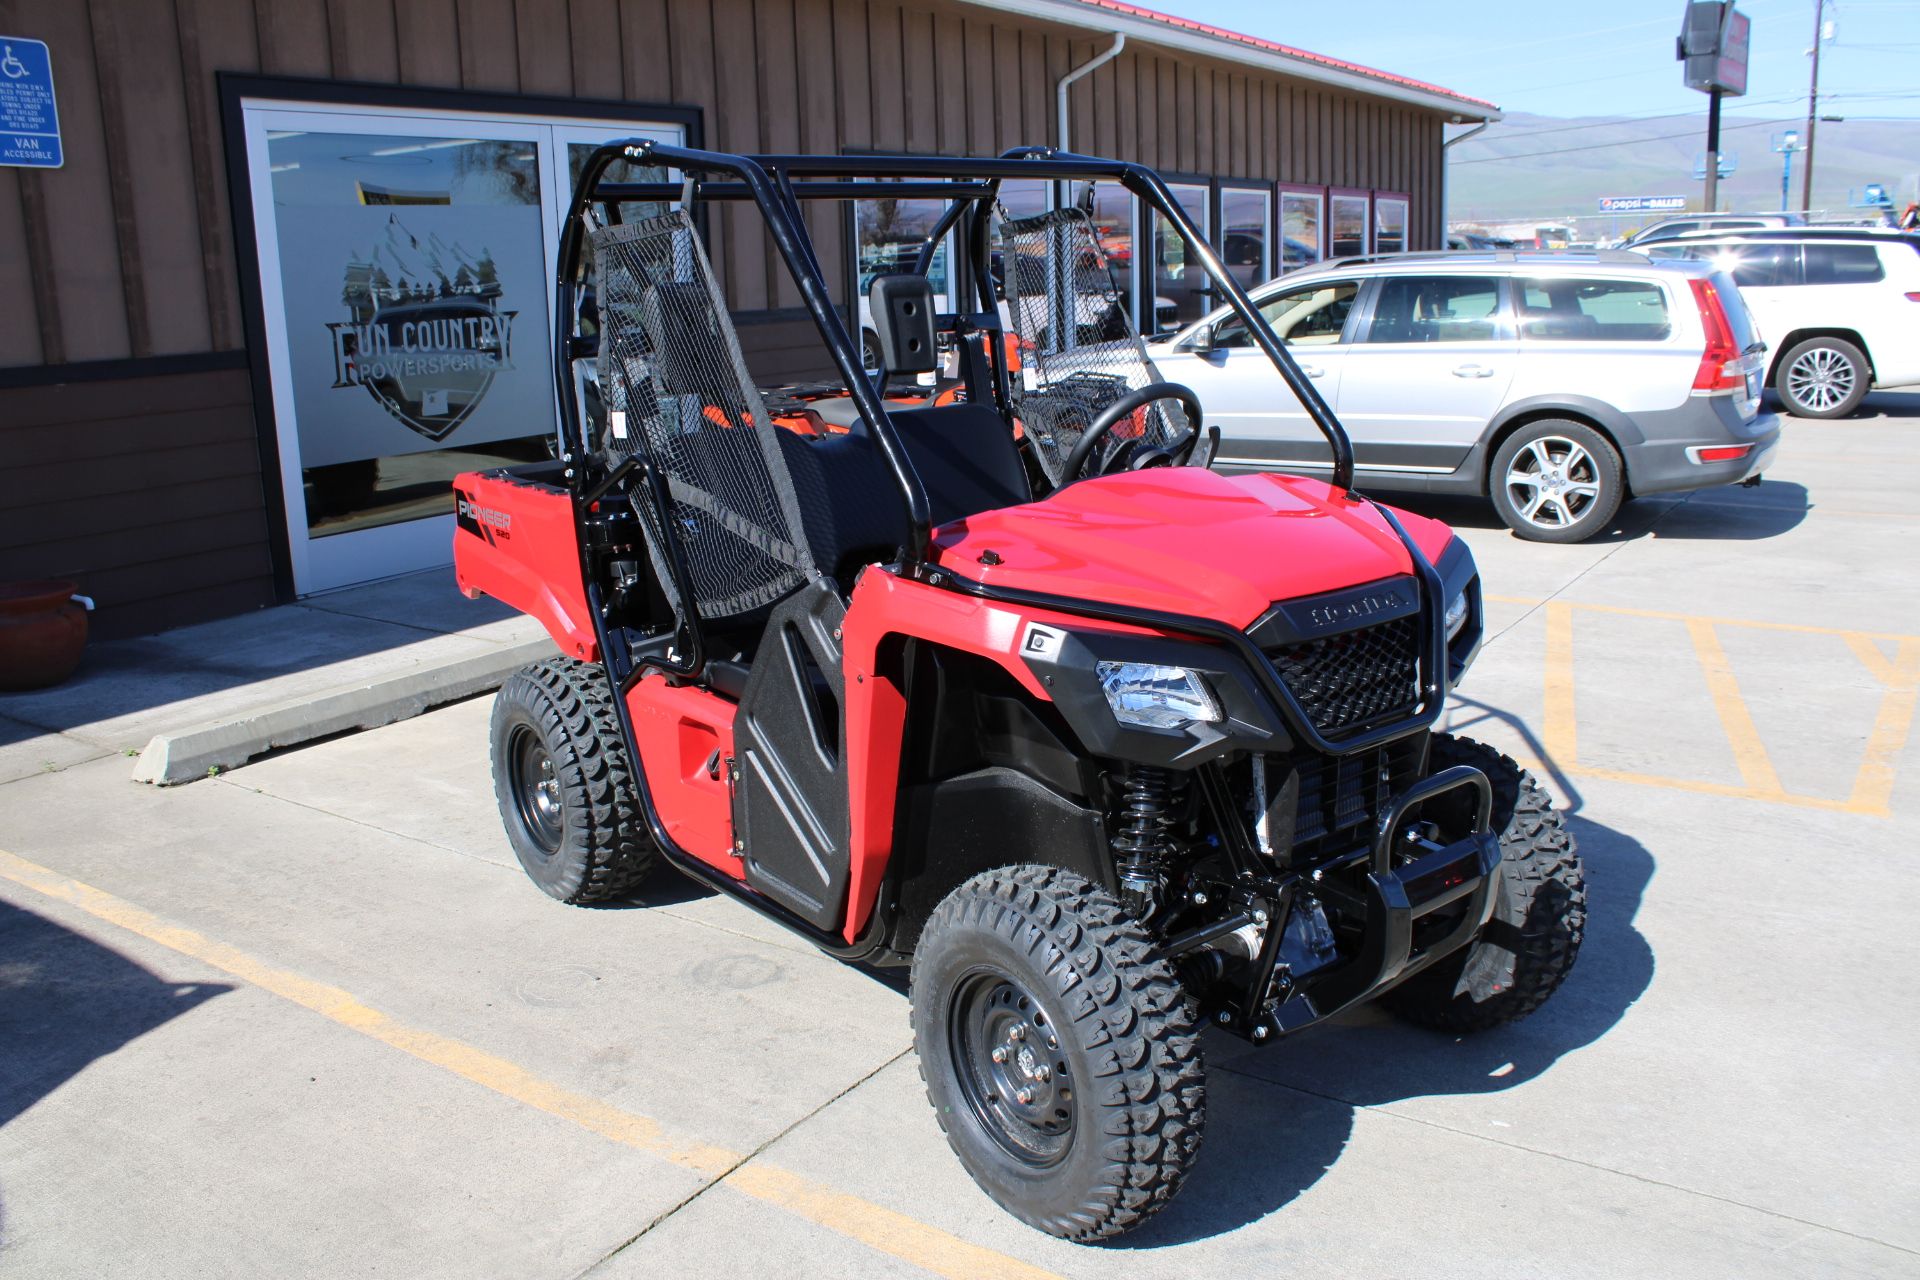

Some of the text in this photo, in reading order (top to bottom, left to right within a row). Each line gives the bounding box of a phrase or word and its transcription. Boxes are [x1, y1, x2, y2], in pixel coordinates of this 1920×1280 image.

[15, 138, 39, 149] VAN
[4, 150, 53, 159] ACCESSIBLE
[325, 310, 519, 388] FUN COUNTRY
[359, 352, 497, 381] POWERSPORTS
[458, 500, 511, 530] PIONEER
[496, 529, 511, 540] 520
